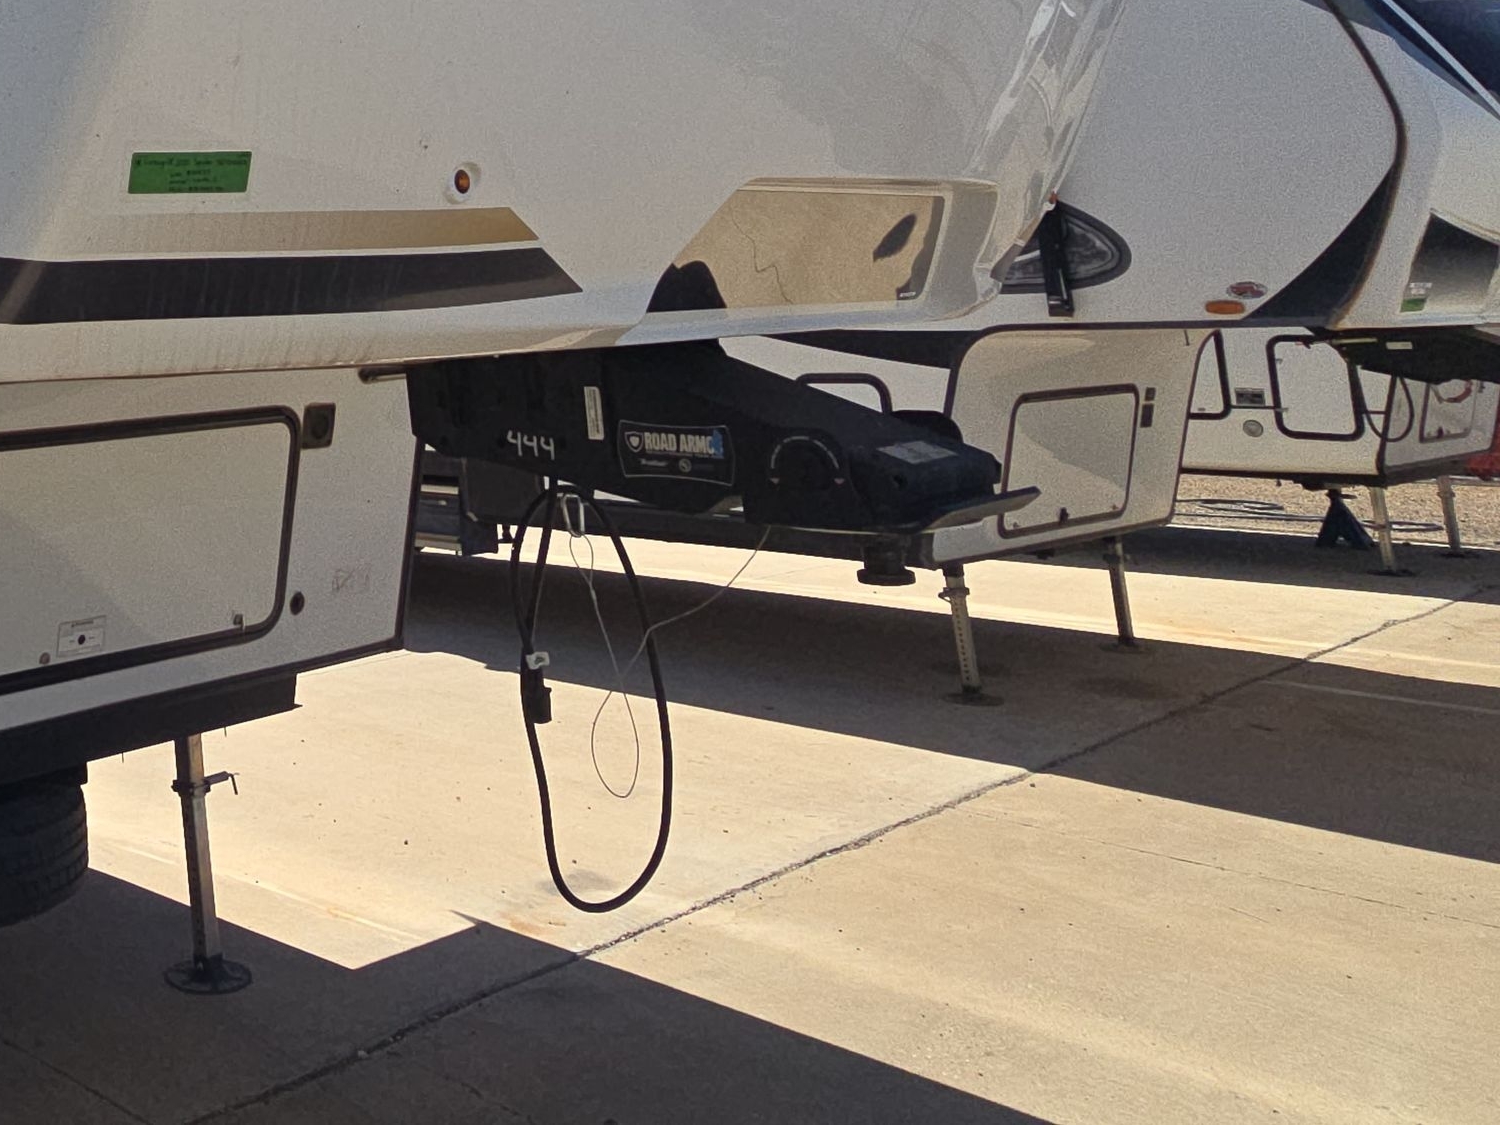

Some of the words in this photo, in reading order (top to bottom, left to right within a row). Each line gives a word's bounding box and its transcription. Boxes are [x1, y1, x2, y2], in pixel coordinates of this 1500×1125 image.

[506, 430, 555, 461] 444
[643, 431, 677, 452] ROAD
[679, 433, 719, 456] ARMO
